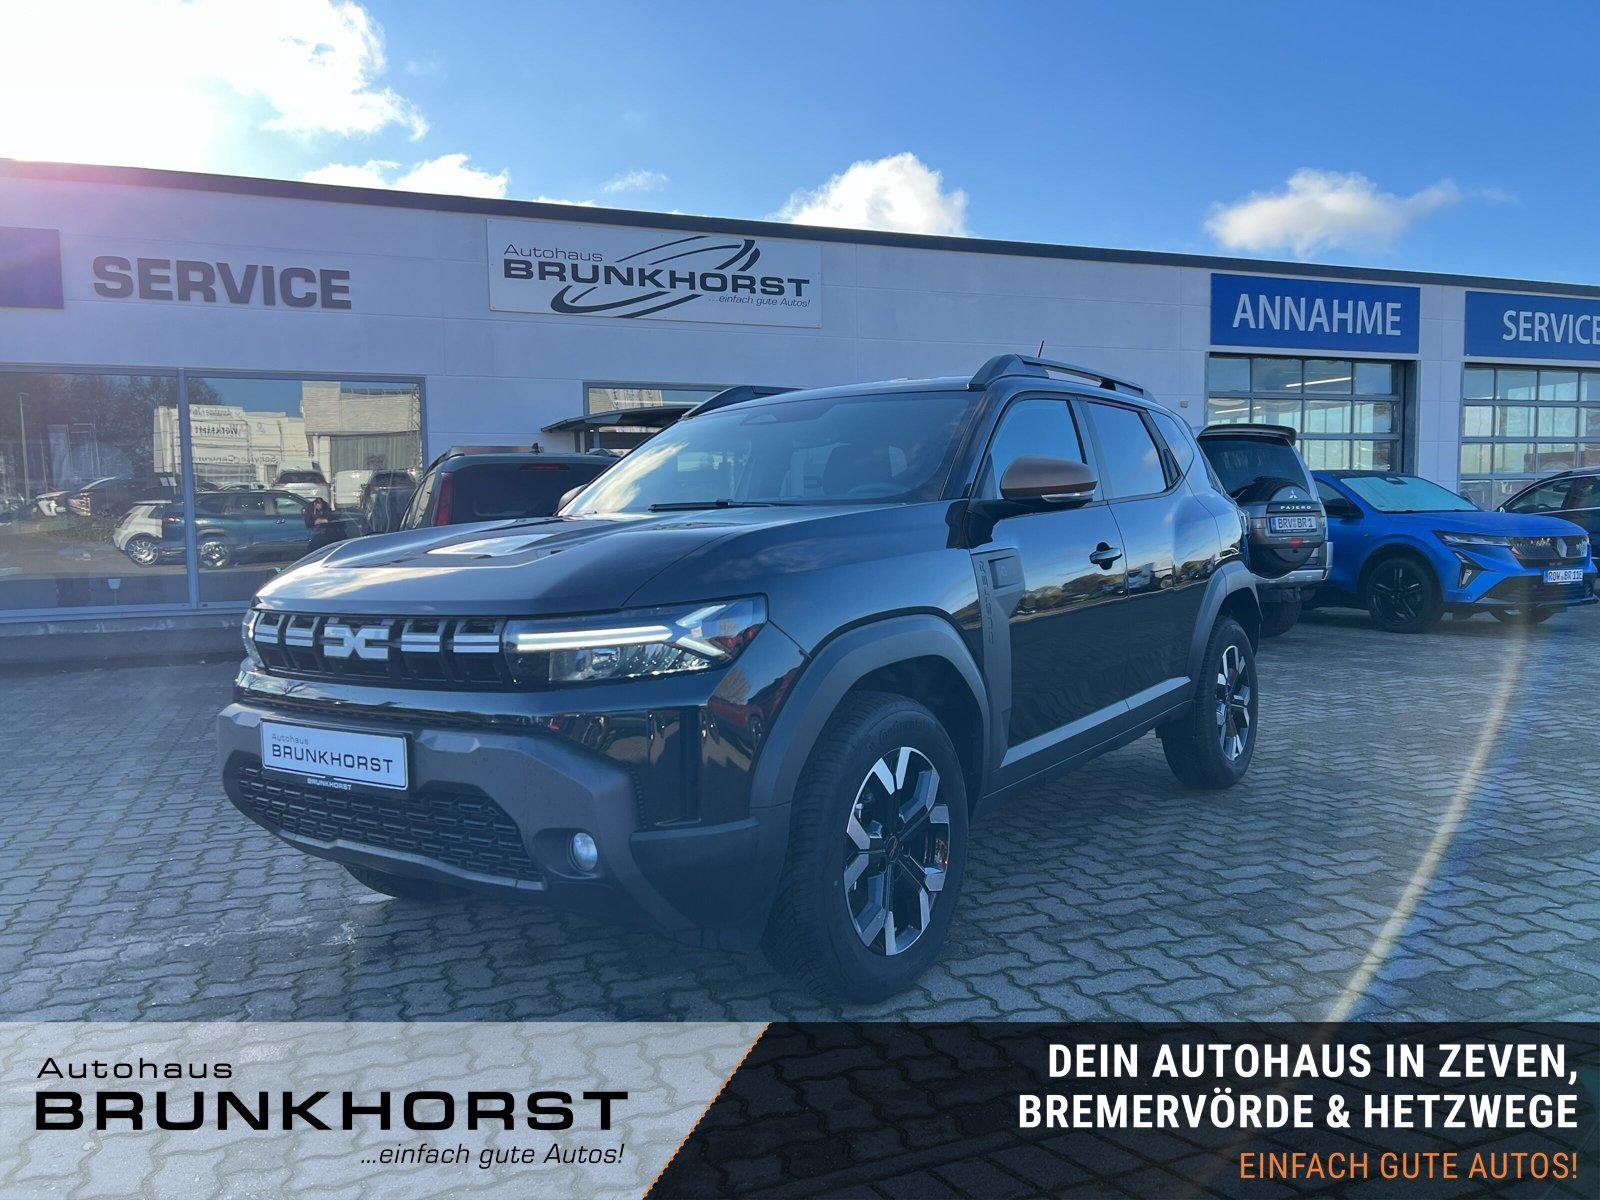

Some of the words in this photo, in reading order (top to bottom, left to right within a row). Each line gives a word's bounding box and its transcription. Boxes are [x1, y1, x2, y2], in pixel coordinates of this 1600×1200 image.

[503, 243, 603, 262] Autohaus
[92, 255, 352, 310] SERVICE
[503, 258, 810, 298] BRUNKHORST
[755, 297, 778, 307] gute
[779, 297, 811, 308] Autos!
[1232, 292, 1403, 337] ANNAHME
[1502, 309, 1600, 346] SERVICE
[1278, 518, 1293, 529] BRV
[1297, 517, 1307, 528] BR
[271, 733, 309, 746] Autohaus
[272, 743, 393, 773] BRUNKHORST
[307, 777, 352, 791] BRUNKHORST
